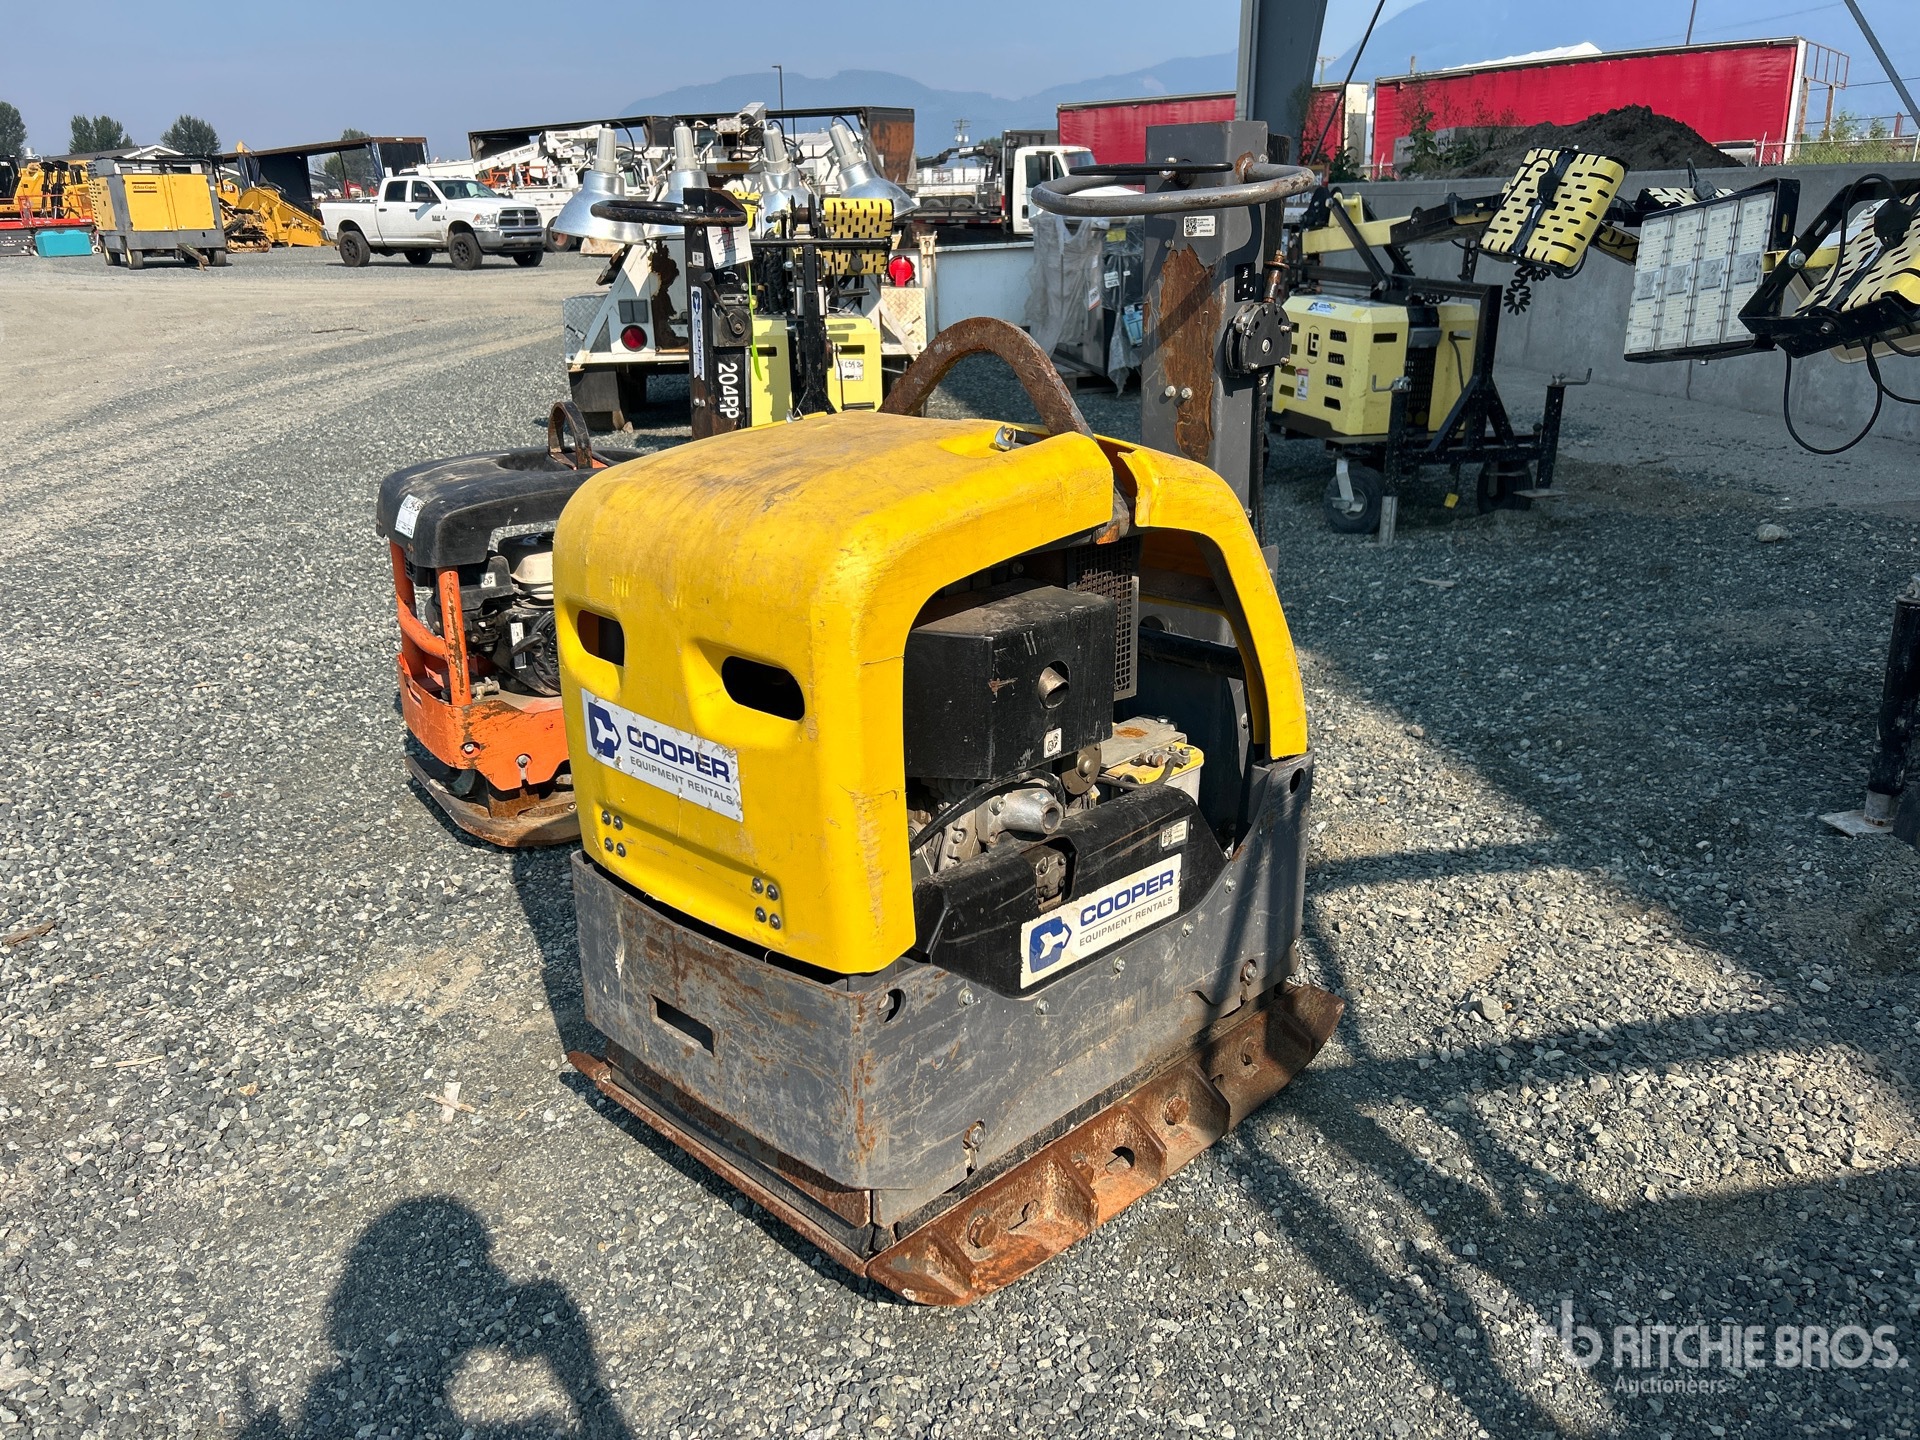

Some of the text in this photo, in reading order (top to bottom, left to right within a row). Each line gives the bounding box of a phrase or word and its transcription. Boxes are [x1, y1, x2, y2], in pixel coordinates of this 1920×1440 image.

[627, 725, 731, 783] COOPER
[630, 756, 734, 806] EQUIPMENT RENTALS
[1079, 896, 1173, 947] EQUIPMENT RENTALS
[1080, 869, 1174, 927] COOPER
